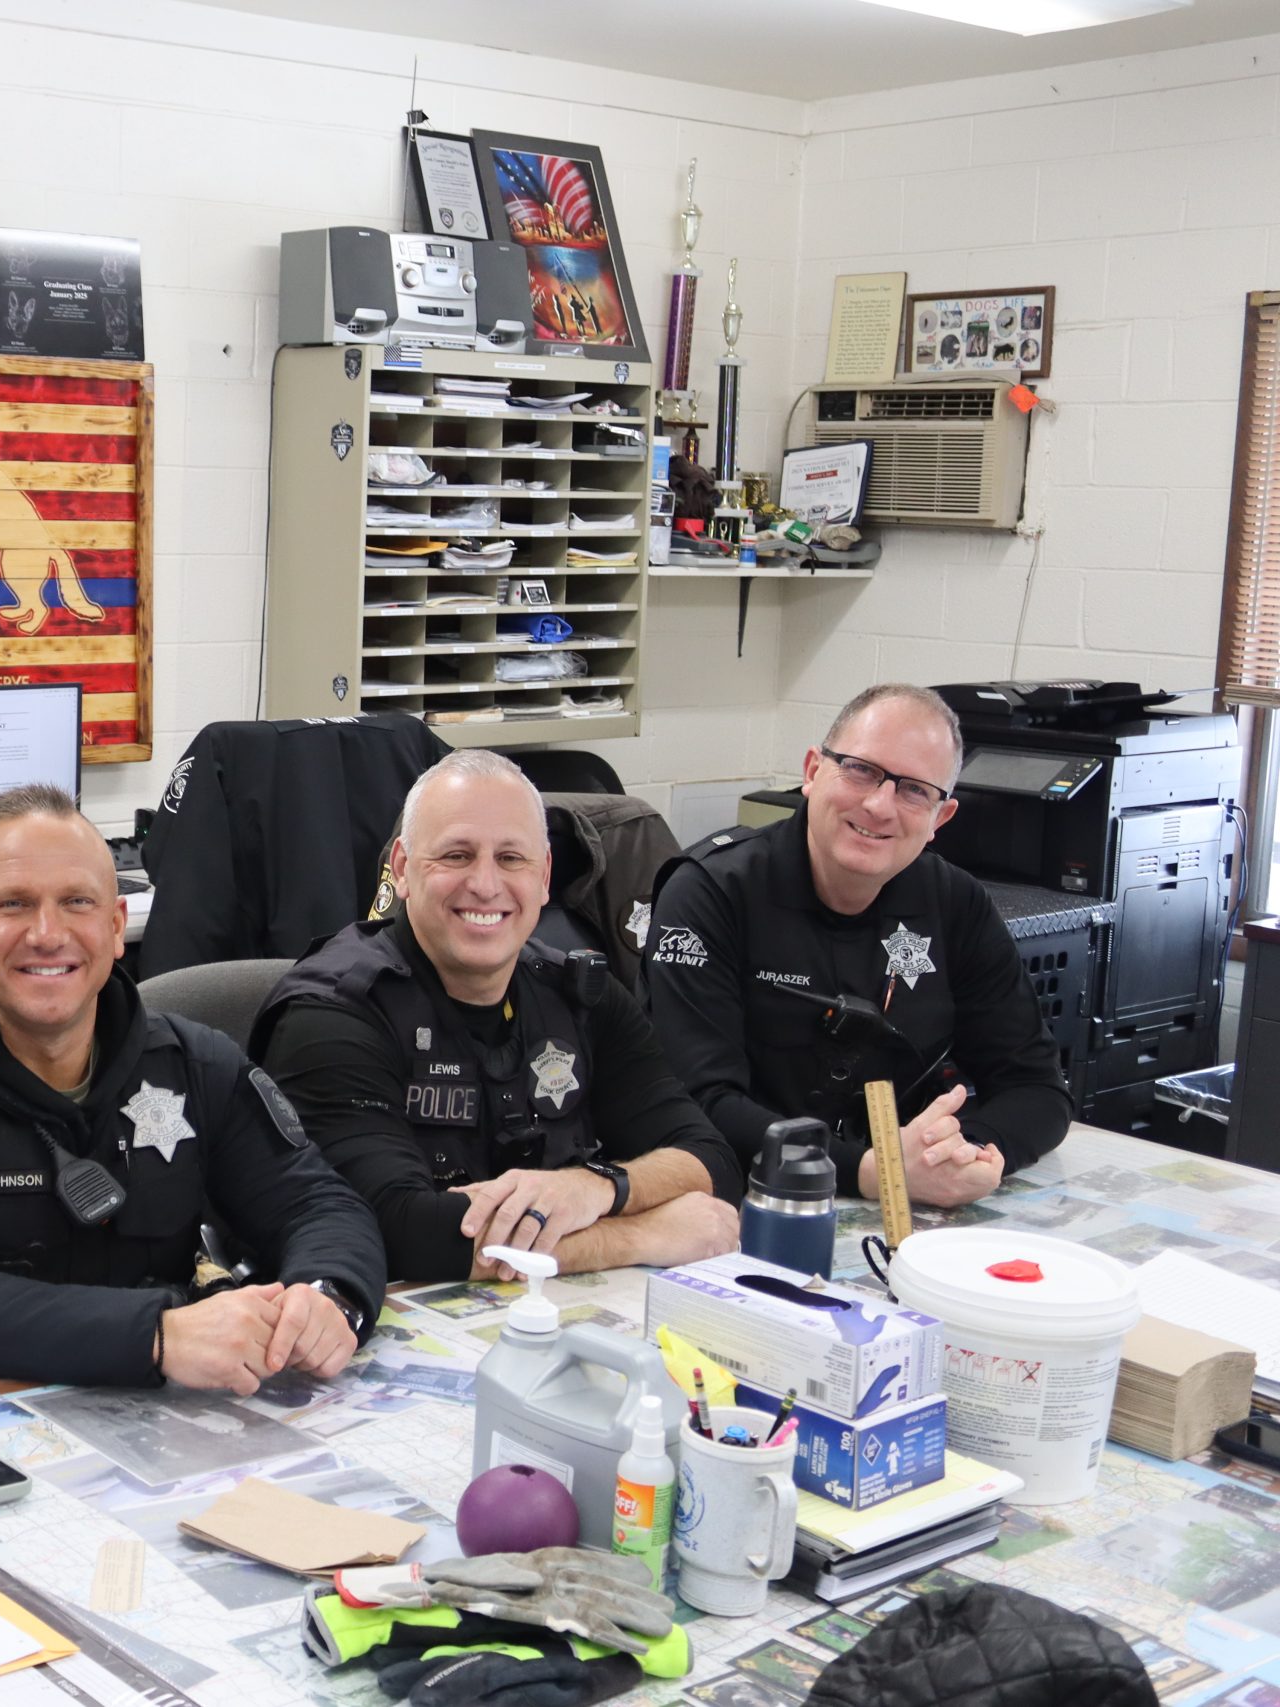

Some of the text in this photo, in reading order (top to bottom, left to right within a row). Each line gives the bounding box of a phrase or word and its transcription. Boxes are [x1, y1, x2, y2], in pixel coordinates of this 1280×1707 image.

[44, 281, 77, 291] Graduating
[77, 283, 93, 291] Class
[50, 291, 73, 300] January
[653, 952, 708, 967] K-9 UNIT
[756, 970, 811, 986] JURASZEK
[429, 1064, 460, 1075] LEWIS
[406, 1085, 476, 1120] POLICE
[841, 1431, 852, 1451] 100
